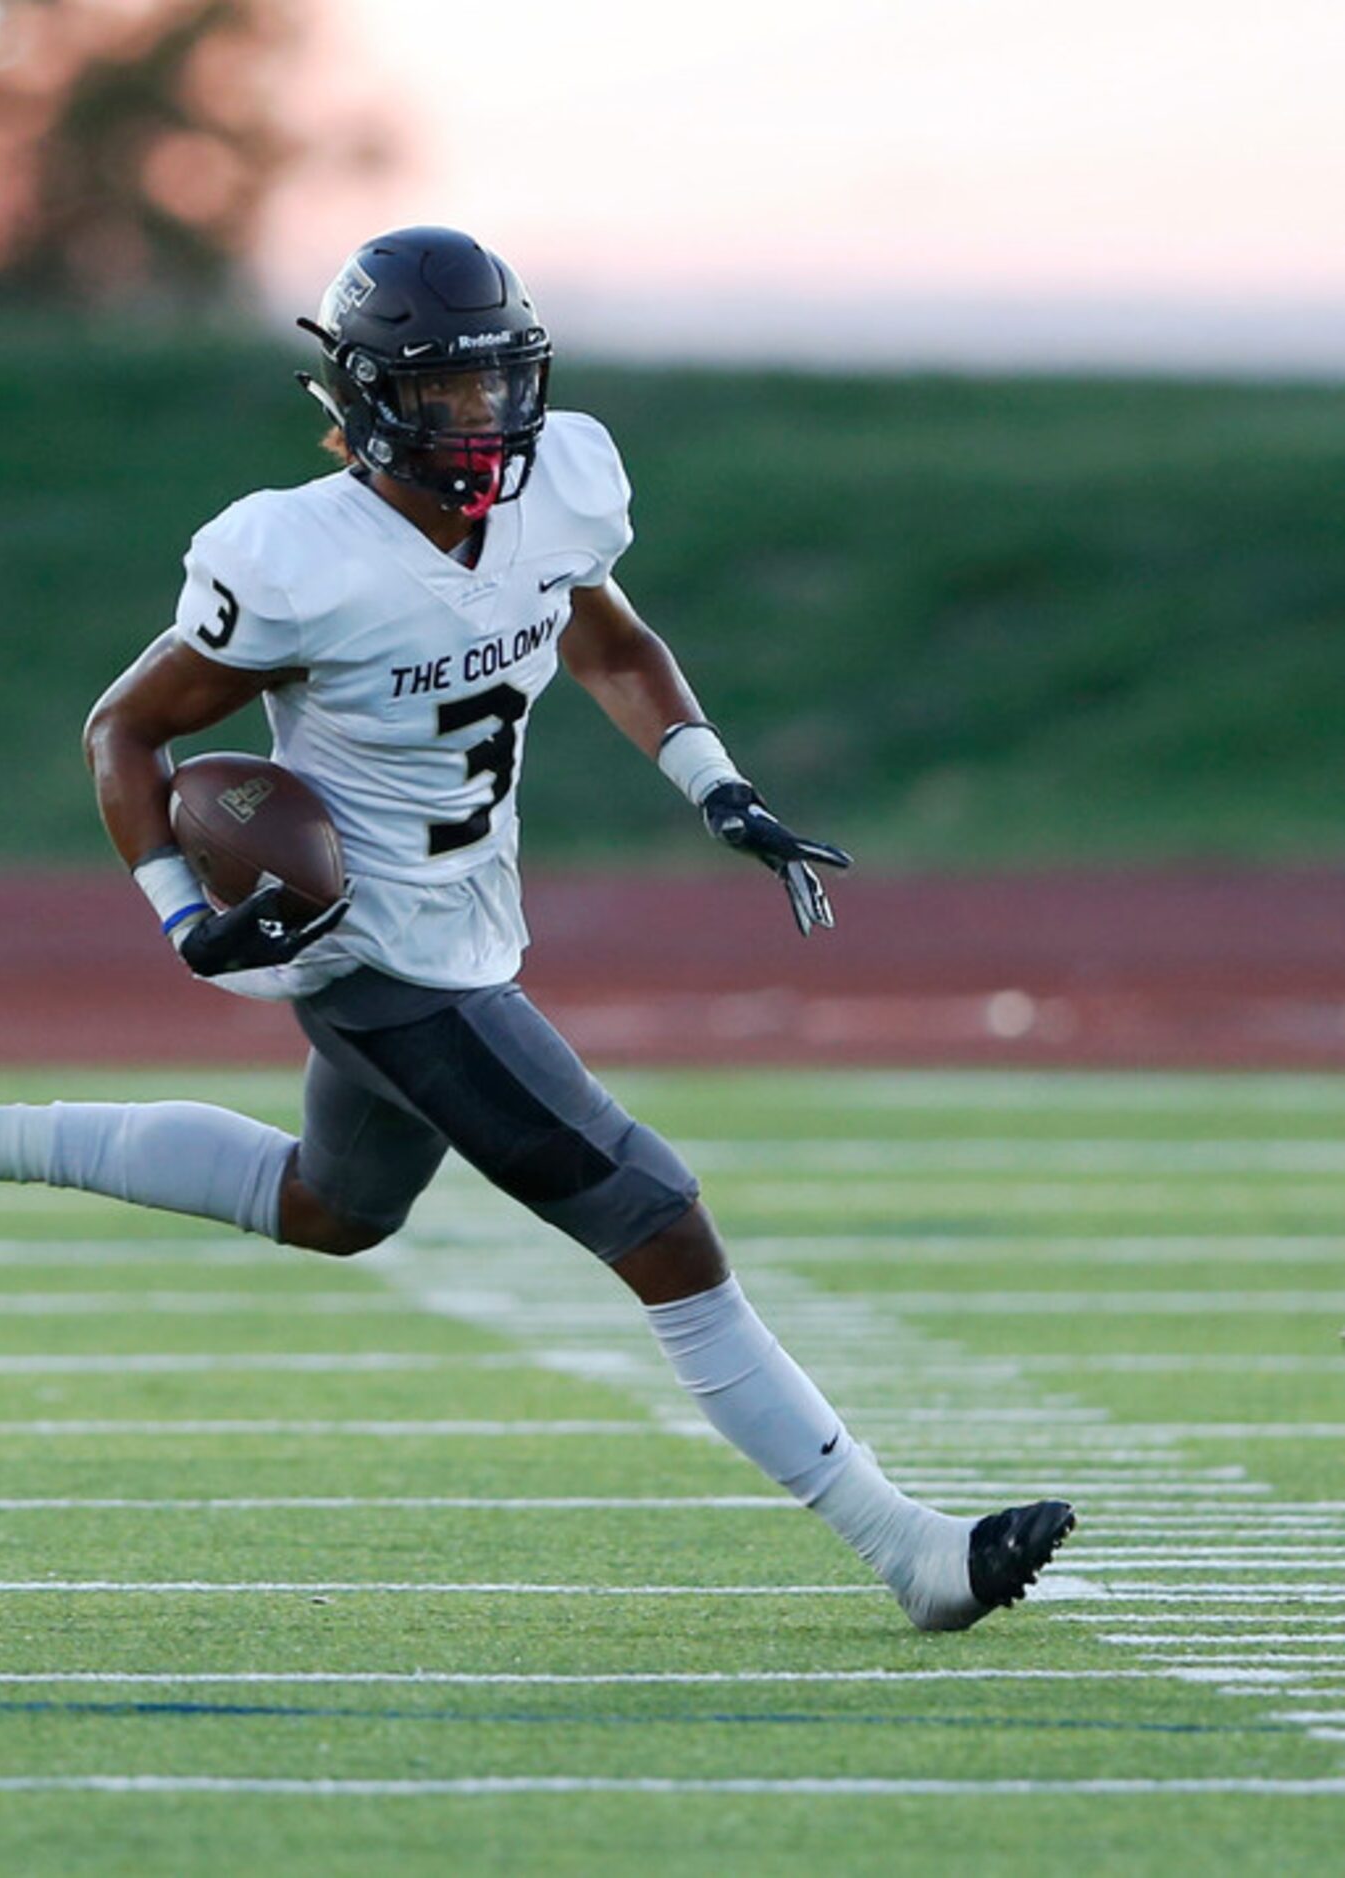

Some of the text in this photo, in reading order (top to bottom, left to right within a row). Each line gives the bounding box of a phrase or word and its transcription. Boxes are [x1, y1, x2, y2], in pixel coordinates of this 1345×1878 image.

[196, 577, 240, 651] 3
[390, 610, 559, 697] THE COLONY
[427, 683, 528, 858] 3
